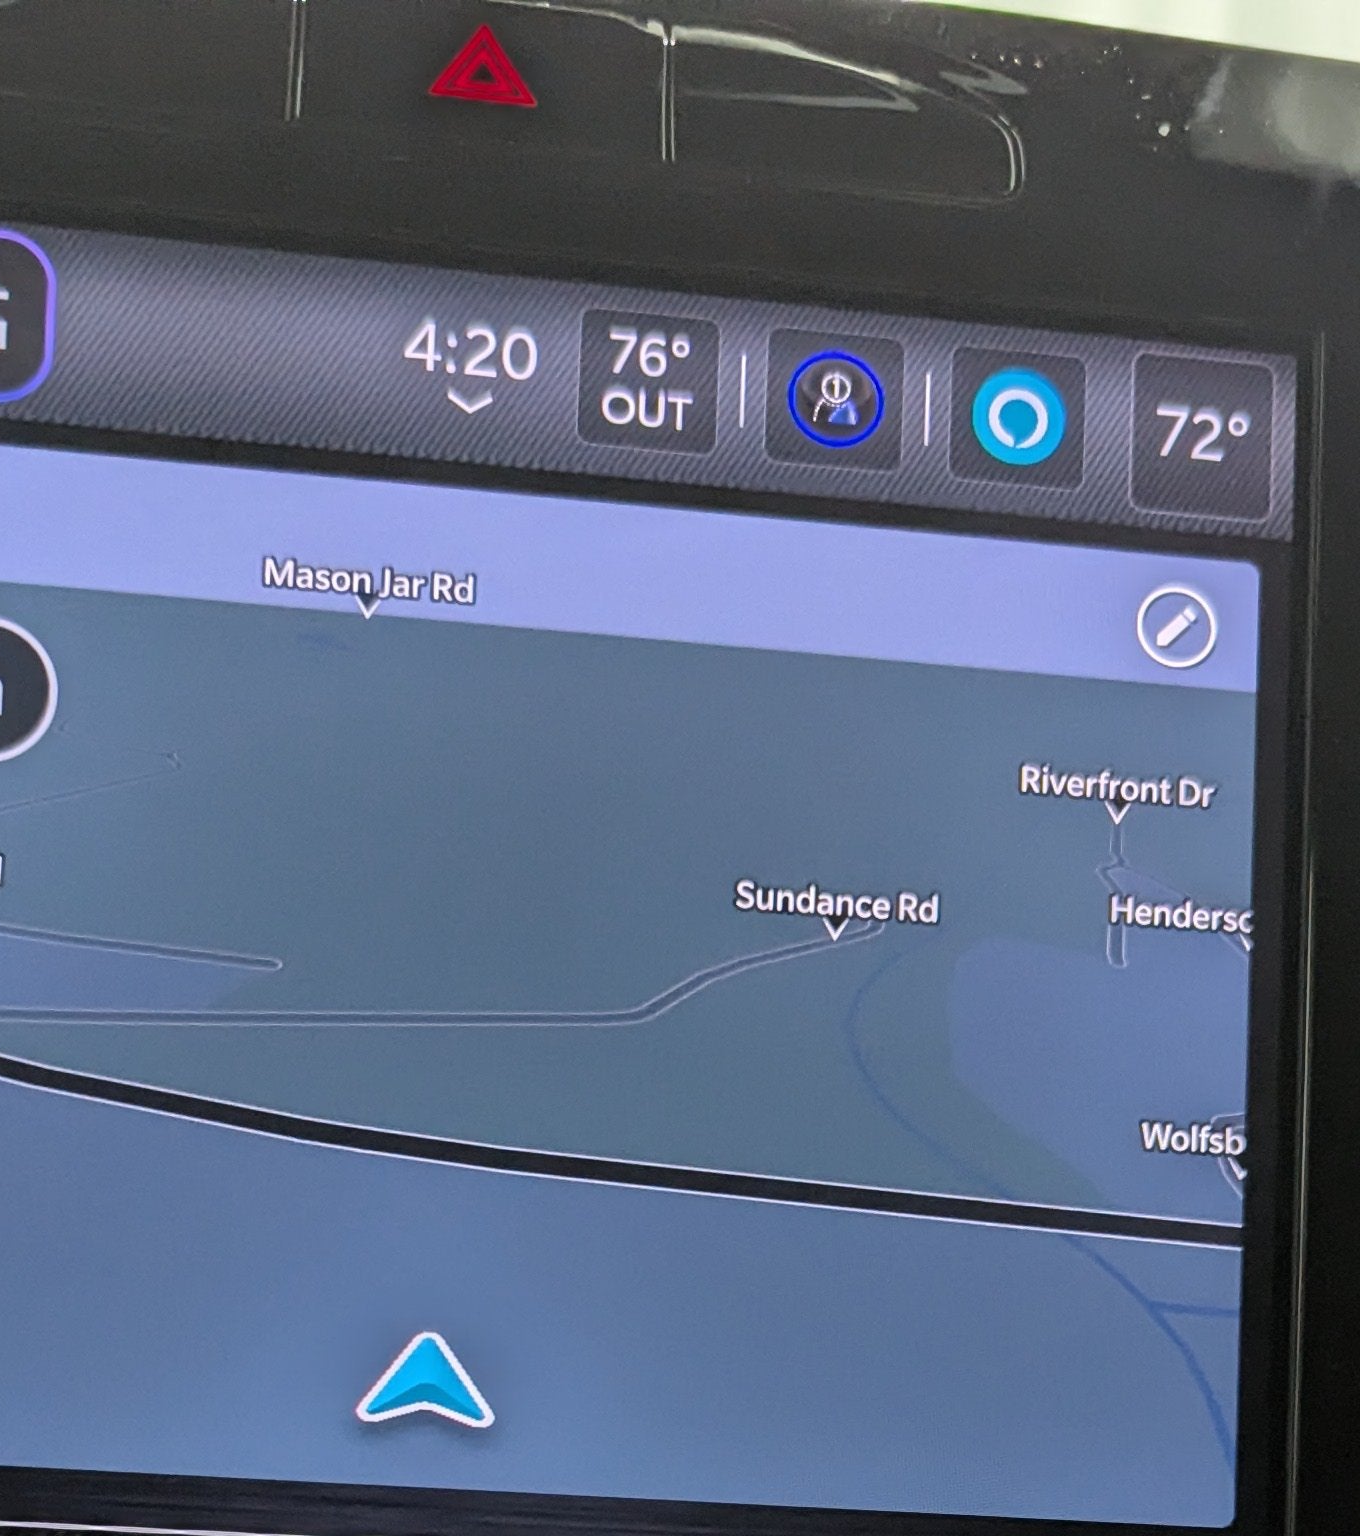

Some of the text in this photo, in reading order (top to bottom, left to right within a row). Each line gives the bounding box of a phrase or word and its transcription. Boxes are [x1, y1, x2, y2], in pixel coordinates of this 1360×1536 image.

[404, 320, 538, 380] 4:20
[609, 330, 690, 378] 76°
[601, 389, 694, 431] OUT
[1156, 405, 1249, 462] 72°
[264, 558, 474, 603] Mason Jar Rd
[1021, 764, 1215, 808] Riverfront Dr
[735, 880, 939, 923] Sundance Rd
[1141, 1117, 1245, 1156] Wolfsb
